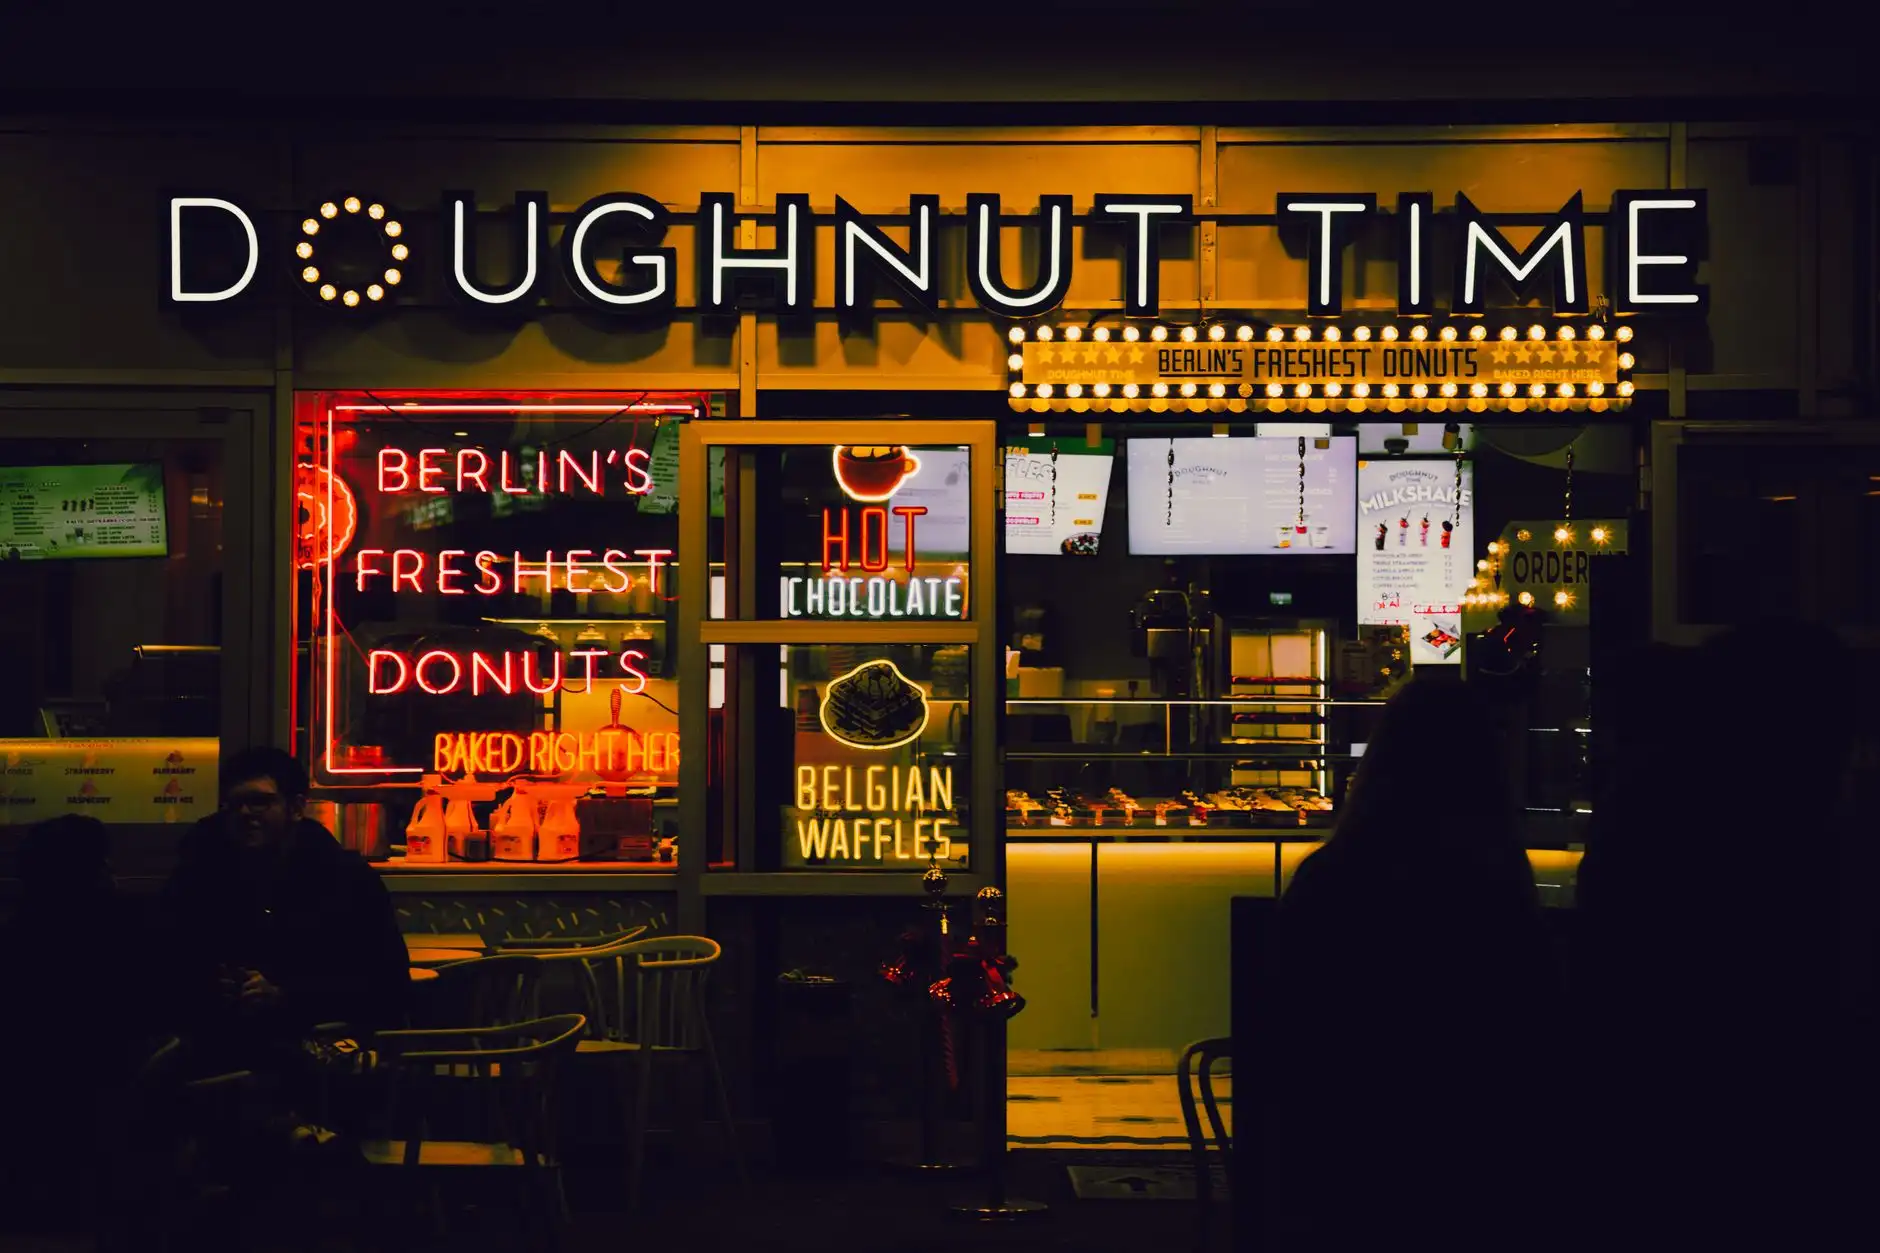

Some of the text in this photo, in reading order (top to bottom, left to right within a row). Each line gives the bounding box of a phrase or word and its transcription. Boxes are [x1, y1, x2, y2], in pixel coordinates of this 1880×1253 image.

[171, 197, 1699, 308] DOUGHNUT TIME
[1047, 369, 1135, 380] DOUGHNUT TIME
[1158, 347, 1478, 378] BERLIN'S FRESHEST DONUTS
[1493, 369, 1601, 379] BAKED RIGHT HERE
[377, 448, 653, 494] BERLIN'S
[1360, 485, 1472, 516] MILKSHAKE
[821, 505, 928, 573] HOT
[356, 548, 673, 595] FRESHEST
[1512, 550, 1588, 584] ORDER
[788, 577, 962, 618] CHOCOLATE
[368, 650, 648, 696] DONUTS
[434, 731, 522, 773] BAKED
[530, 731, 621, 773] RIGHT
[797, 765, 953, 812] BELGIAN
[797, 818, 951, 860] WAFFLES
